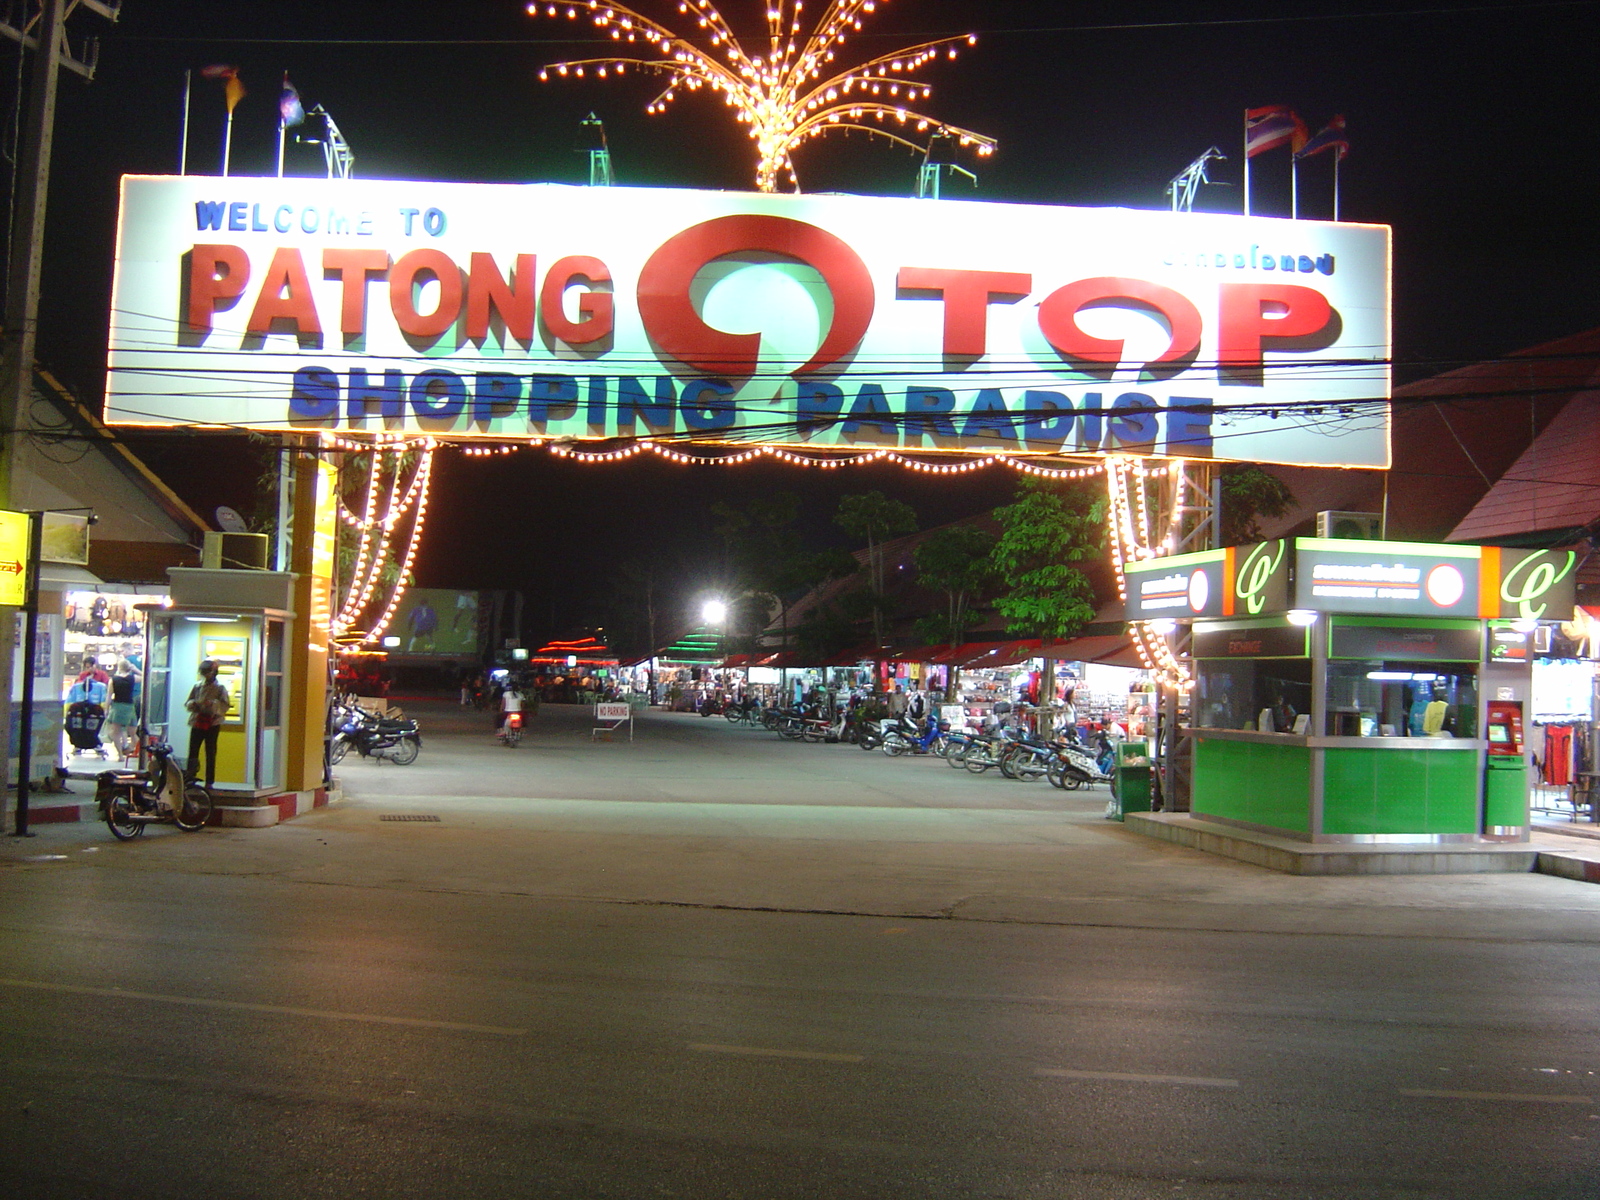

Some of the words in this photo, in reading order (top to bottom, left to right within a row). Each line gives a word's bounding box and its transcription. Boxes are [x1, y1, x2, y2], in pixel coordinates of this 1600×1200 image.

[195, 200, 373, 235] WELCOME
[400, 207, 447, 237] TO
[184, 243, 614, 352] PATONG
[288, 366, 737, 431] SHOPPING
[797, 382, 1213, 450] PARADISE
[599, 705, 606, 717] NO
[607, 705, 628, 717] PARKING
